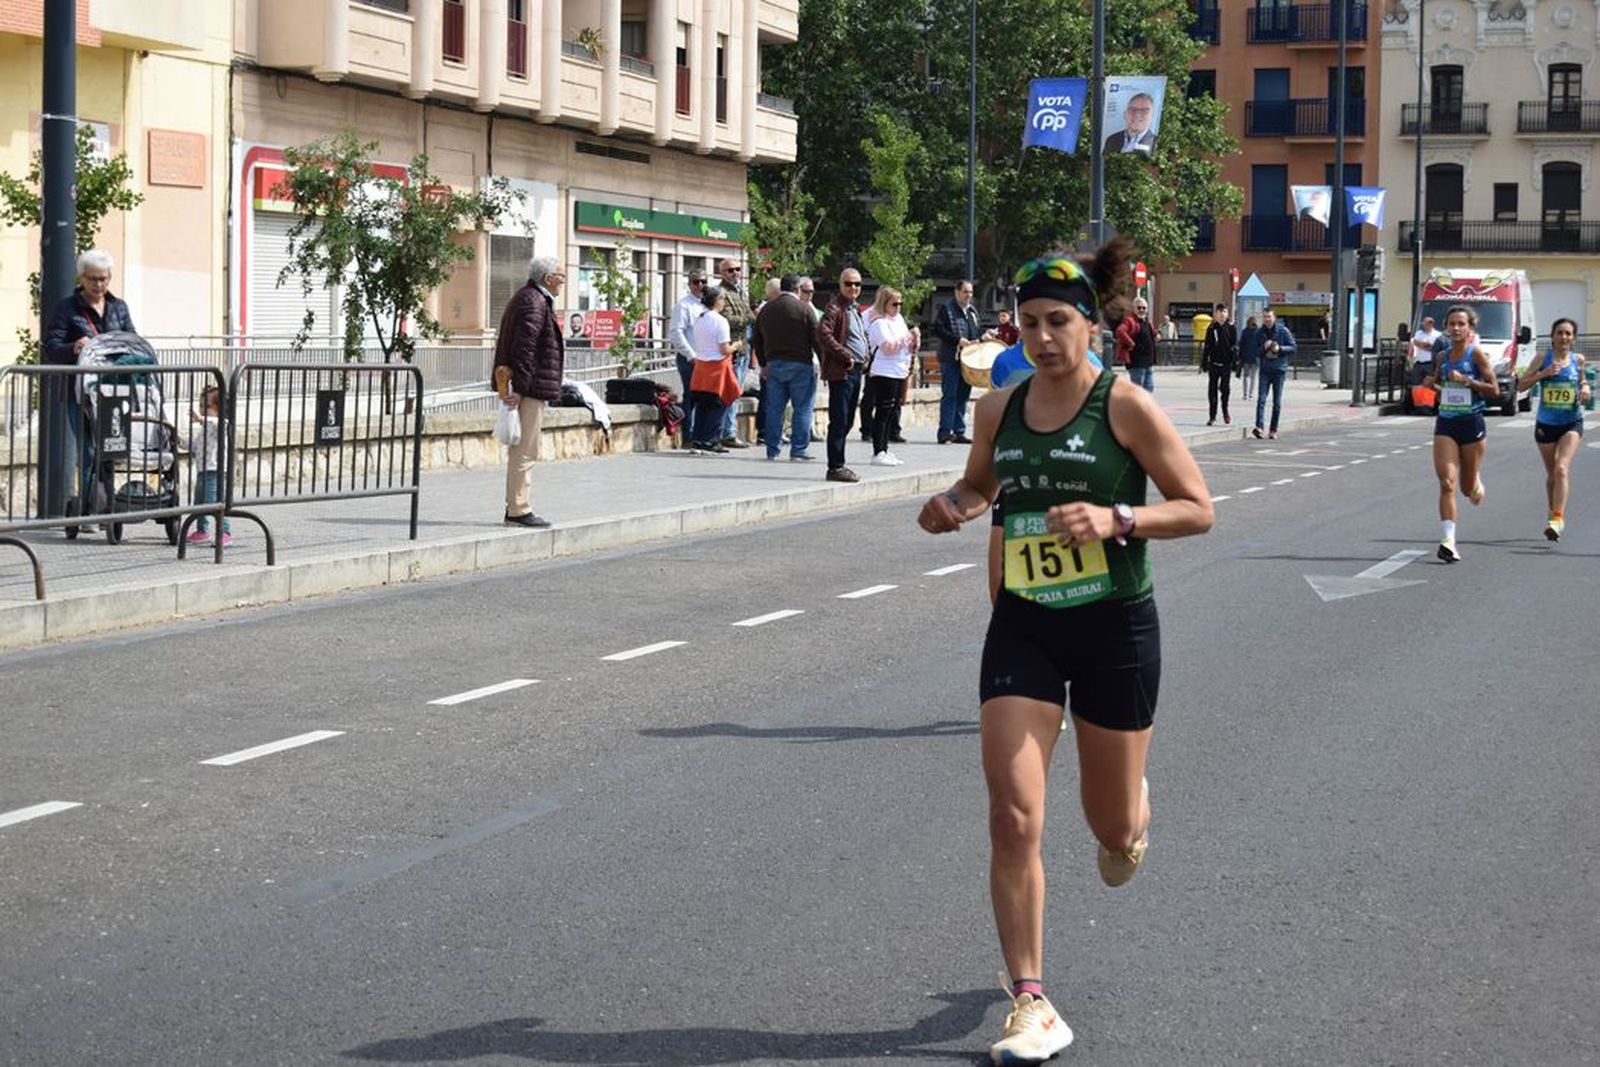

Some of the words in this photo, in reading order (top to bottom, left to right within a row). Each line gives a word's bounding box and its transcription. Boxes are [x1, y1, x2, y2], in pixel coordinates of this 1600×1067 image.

[1038, 96, 1072, 106] VOTA
[1353, 195, 1378, 203] VOTA
[1548, 389, 1571, 402] 179
[1018, 538, 1084, 581] 151
[1066, 582, 1104, 598] RURAL
